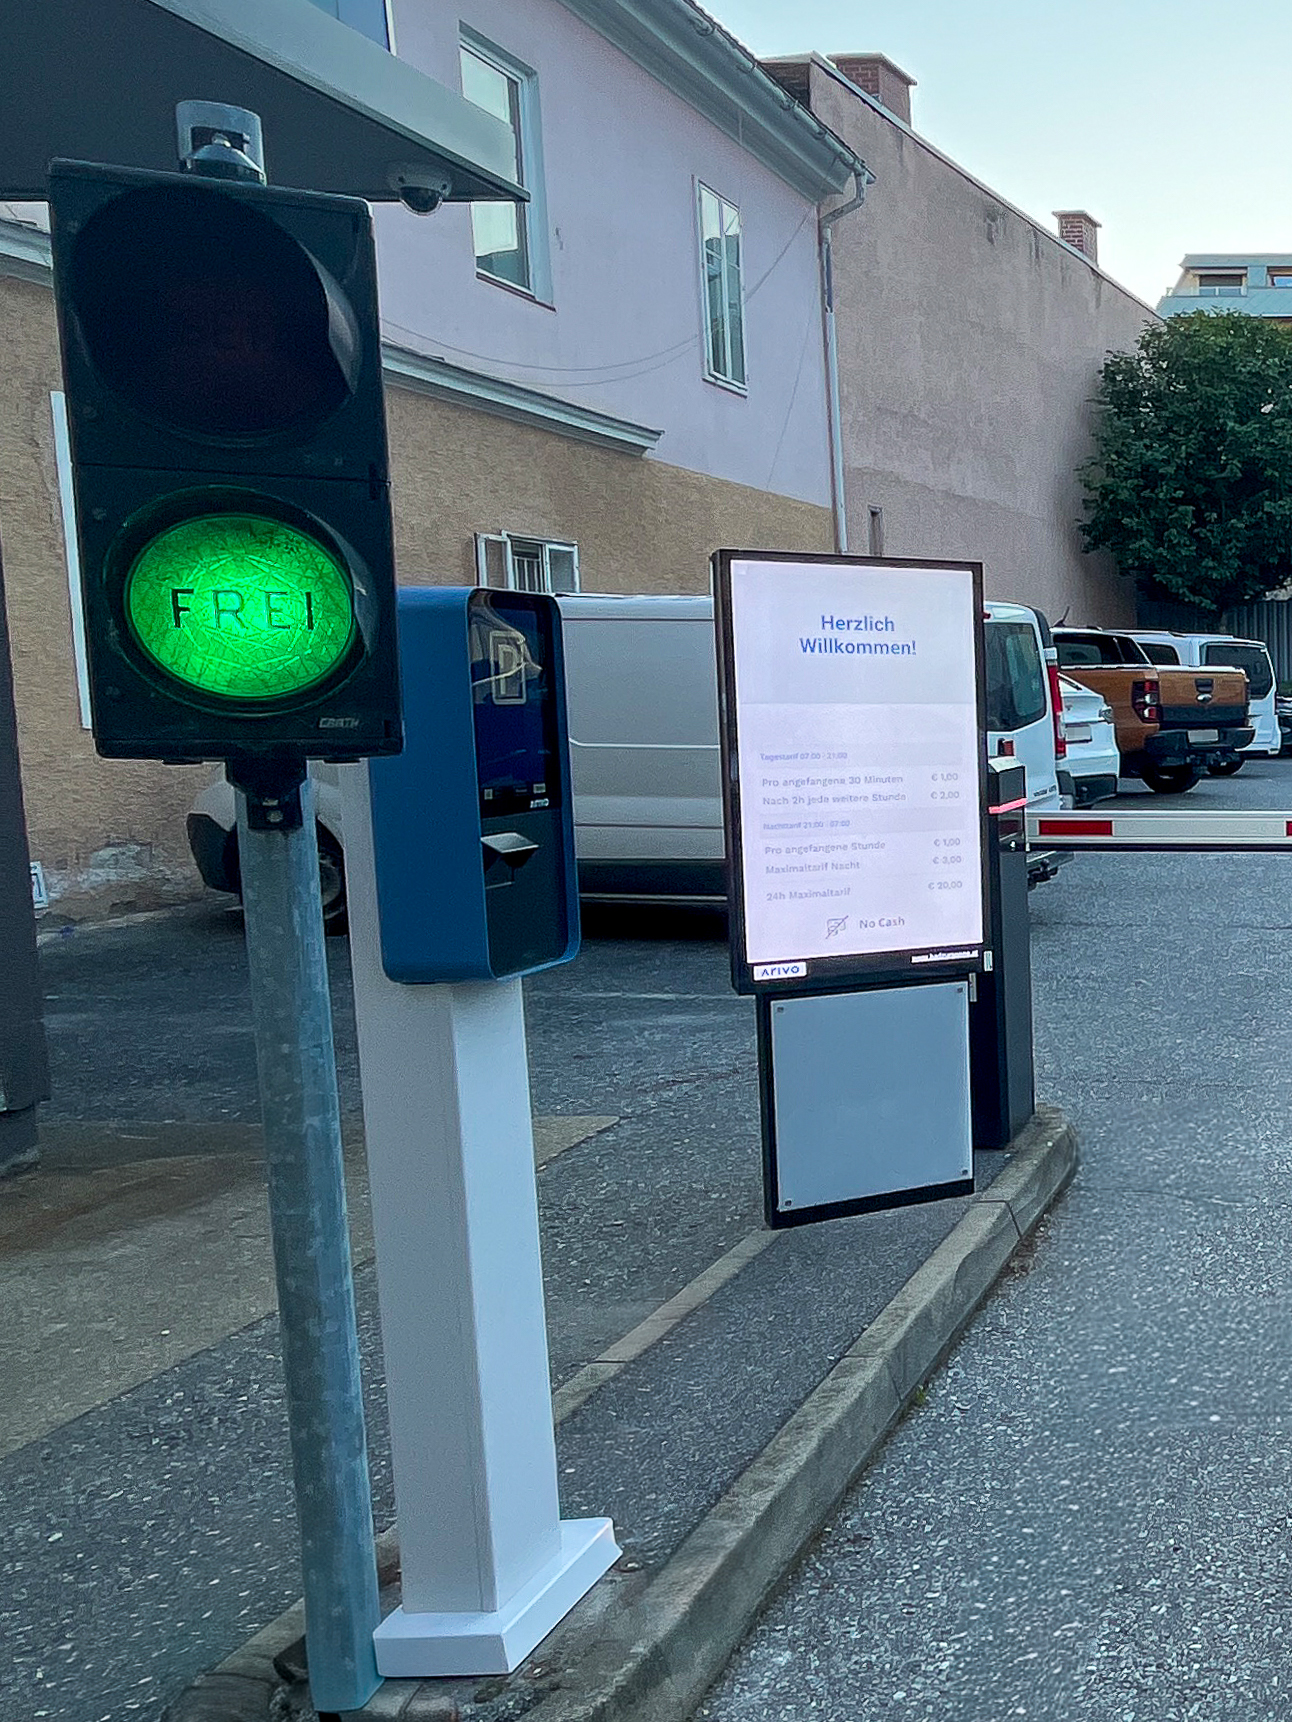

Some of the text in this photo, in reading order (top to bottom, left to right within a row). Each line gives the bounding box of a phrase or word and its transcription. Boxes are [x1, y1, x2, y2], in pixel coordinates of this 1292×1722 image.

[171, 588, 316, 630] FREI
[820, 615, 895, 632] Herzlich
[799, 638, 917, 656] Willkommen!
[762, 772, 958, 788] Pro angefangene 30 Minuten € 1,00
[762, 797, 789, 805] Nach
[792, 796, 805, 804] 2h
[807, 796, 830, 806] jede
[832, 794, 869, 803] weitere
[872, 793, 906, 802] Stunde
[940, 791, 960, 800] 2,00
[764, 838, 960, 856] Pro angefangene Stunde € 1,00
[765, 856, 962, 874] Maximaltarif Nacht € 3,00
[766, 881, 963, 901] 24h Maximaltarif € 20,00
[859, 916, 906, 929] No Cash
